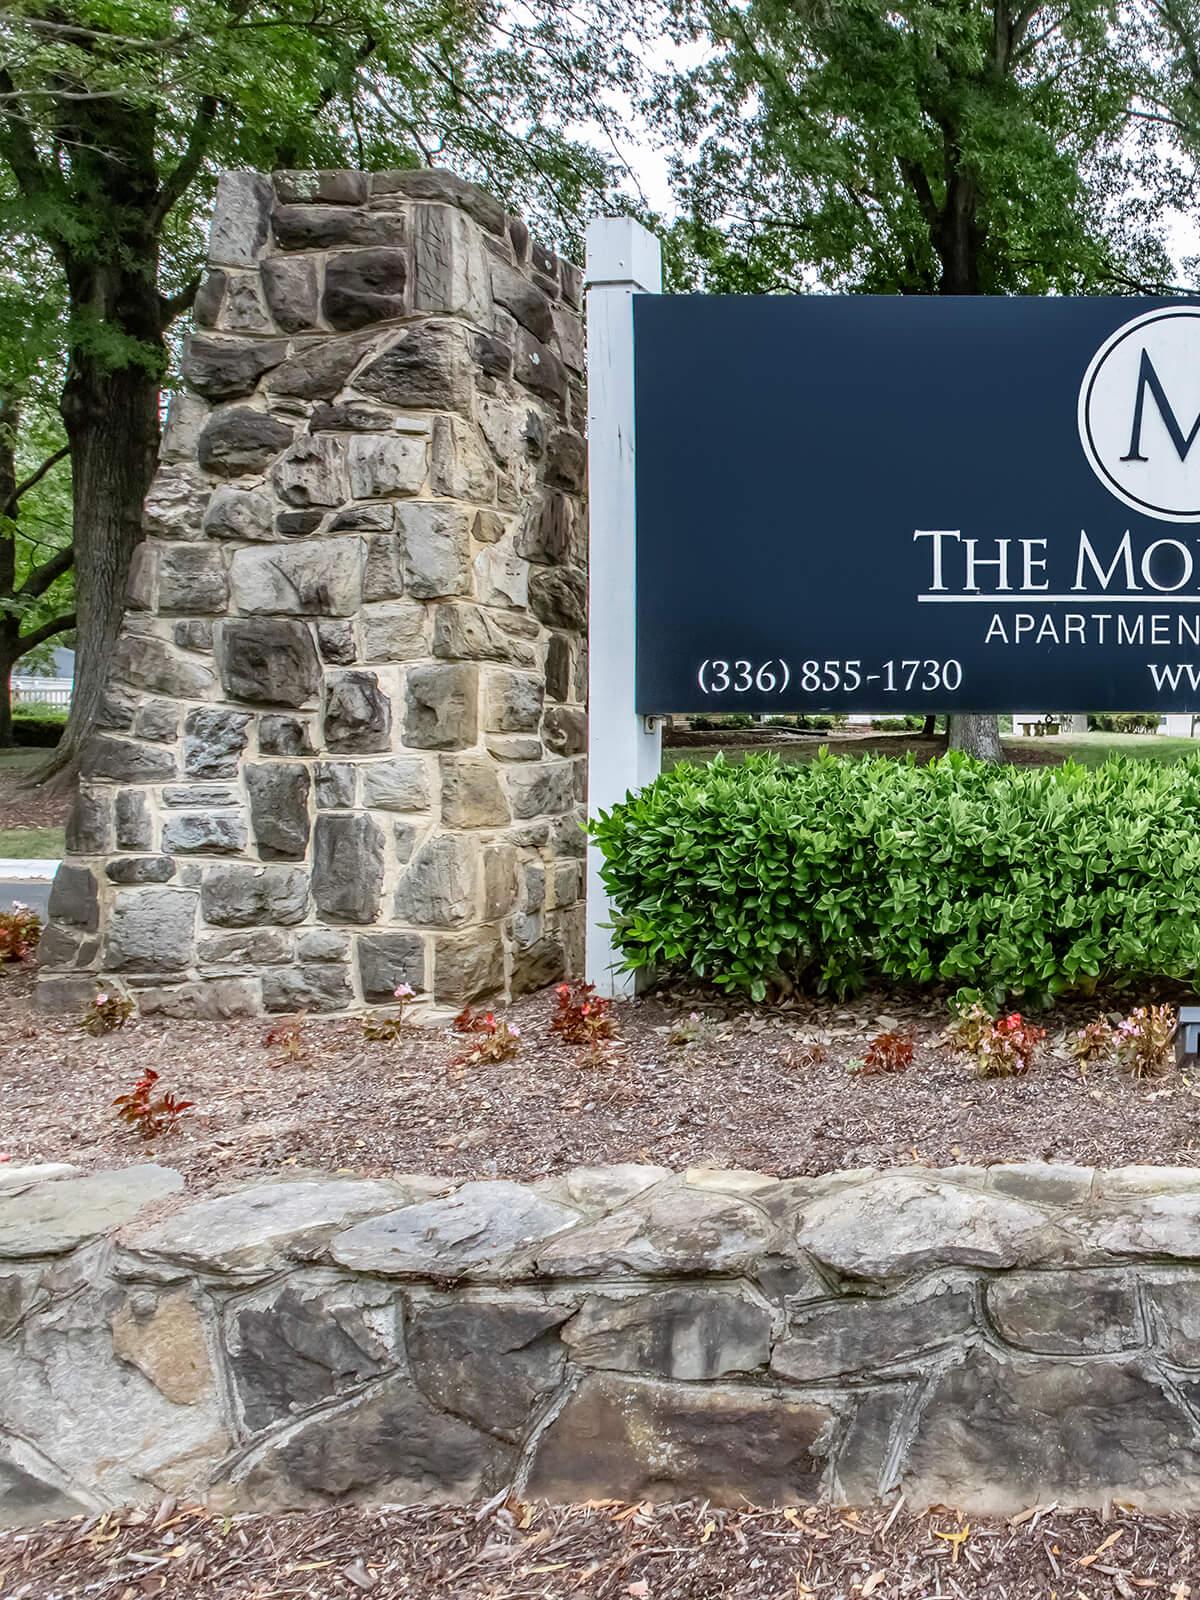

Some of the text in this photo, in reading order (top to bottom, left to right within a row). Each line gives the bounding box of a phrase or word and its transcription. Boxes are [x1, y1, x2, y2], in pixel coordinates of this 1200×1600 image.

[913, 528, 1050, 592] THE
[697, 657, 963, 694] (336) 855-1730
